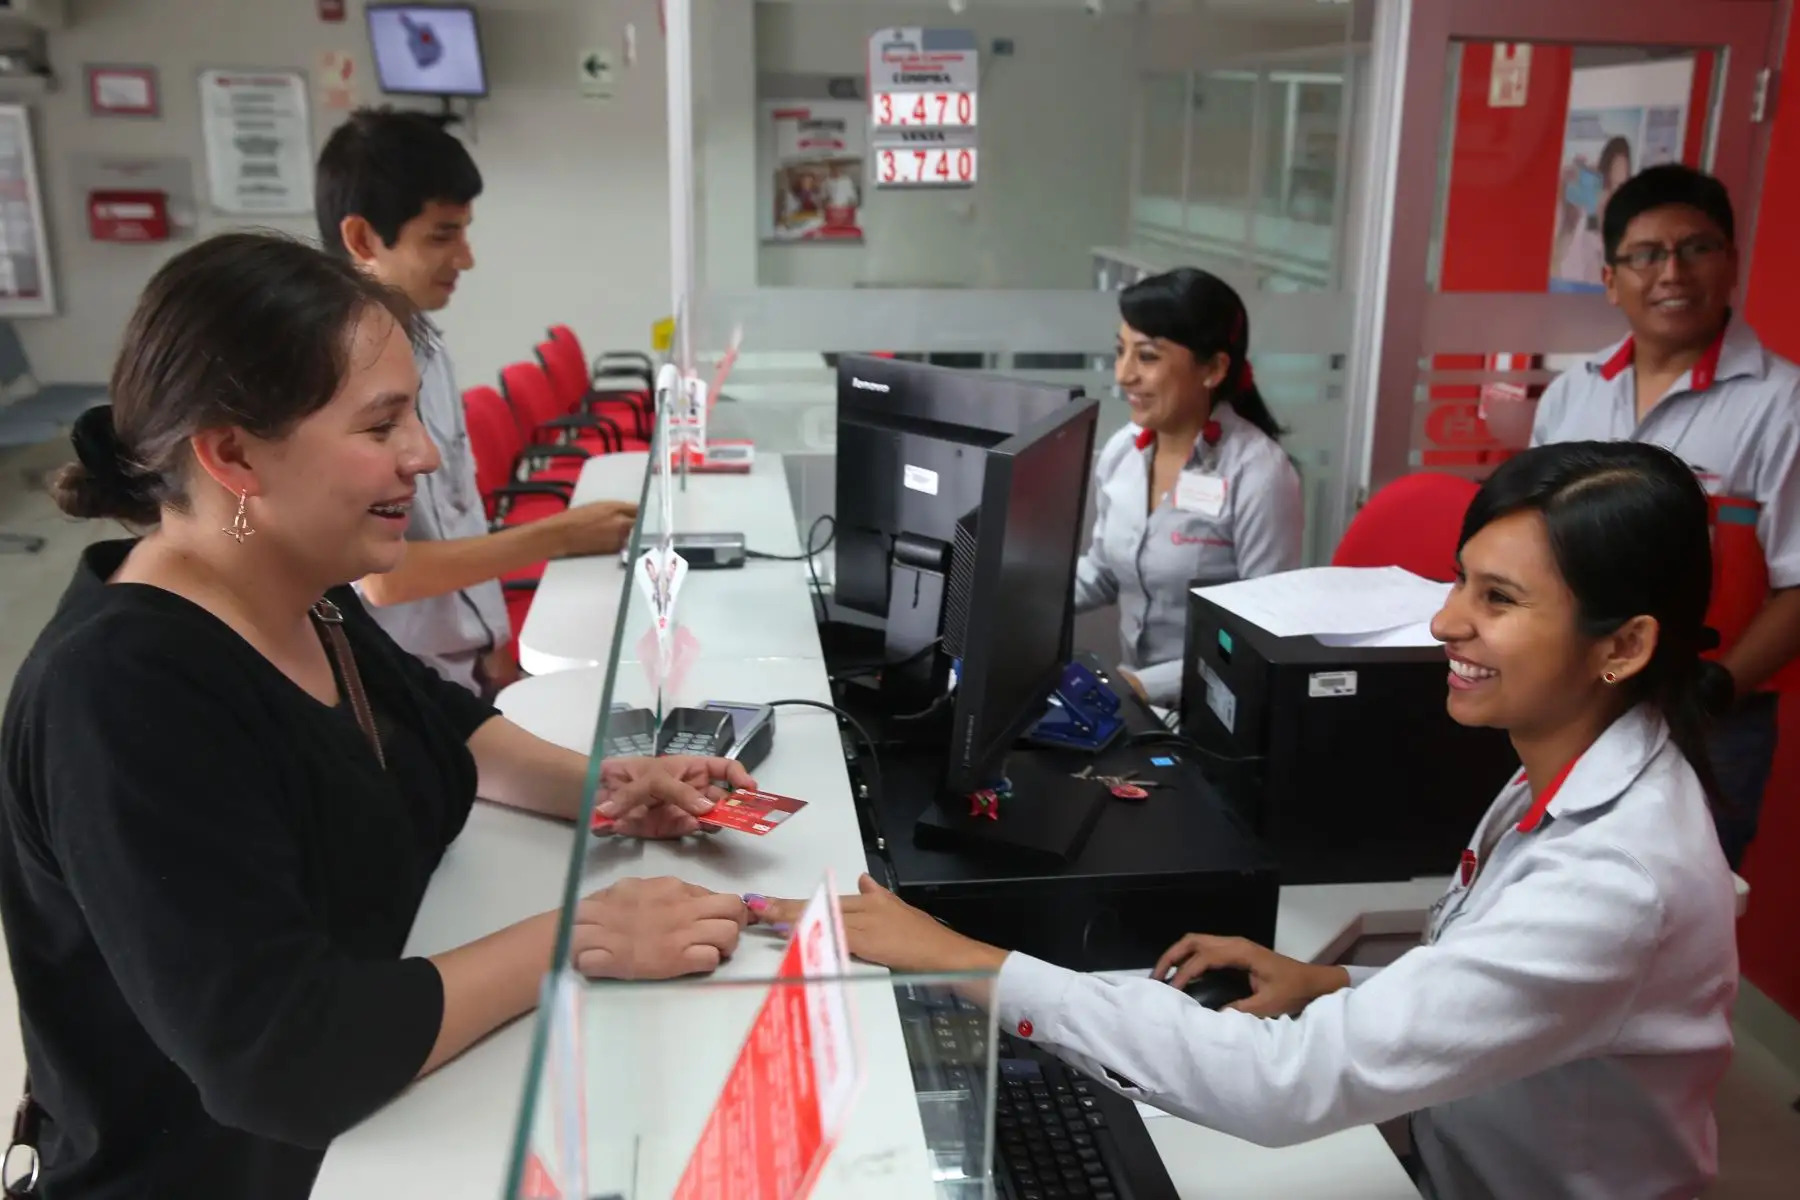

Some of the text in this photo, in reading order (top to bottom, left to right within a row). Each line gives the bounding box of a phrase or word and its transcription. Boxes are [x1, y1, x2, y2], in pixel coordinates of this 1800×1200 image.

[892, 73, 952, 84] COMPRA
[880, 93, 971, 126] 3.470
[901, 131, 945, 141] VENTA
[883, 149, 971, 182] 3.740
[852, 376, 891, 393] lenovo
